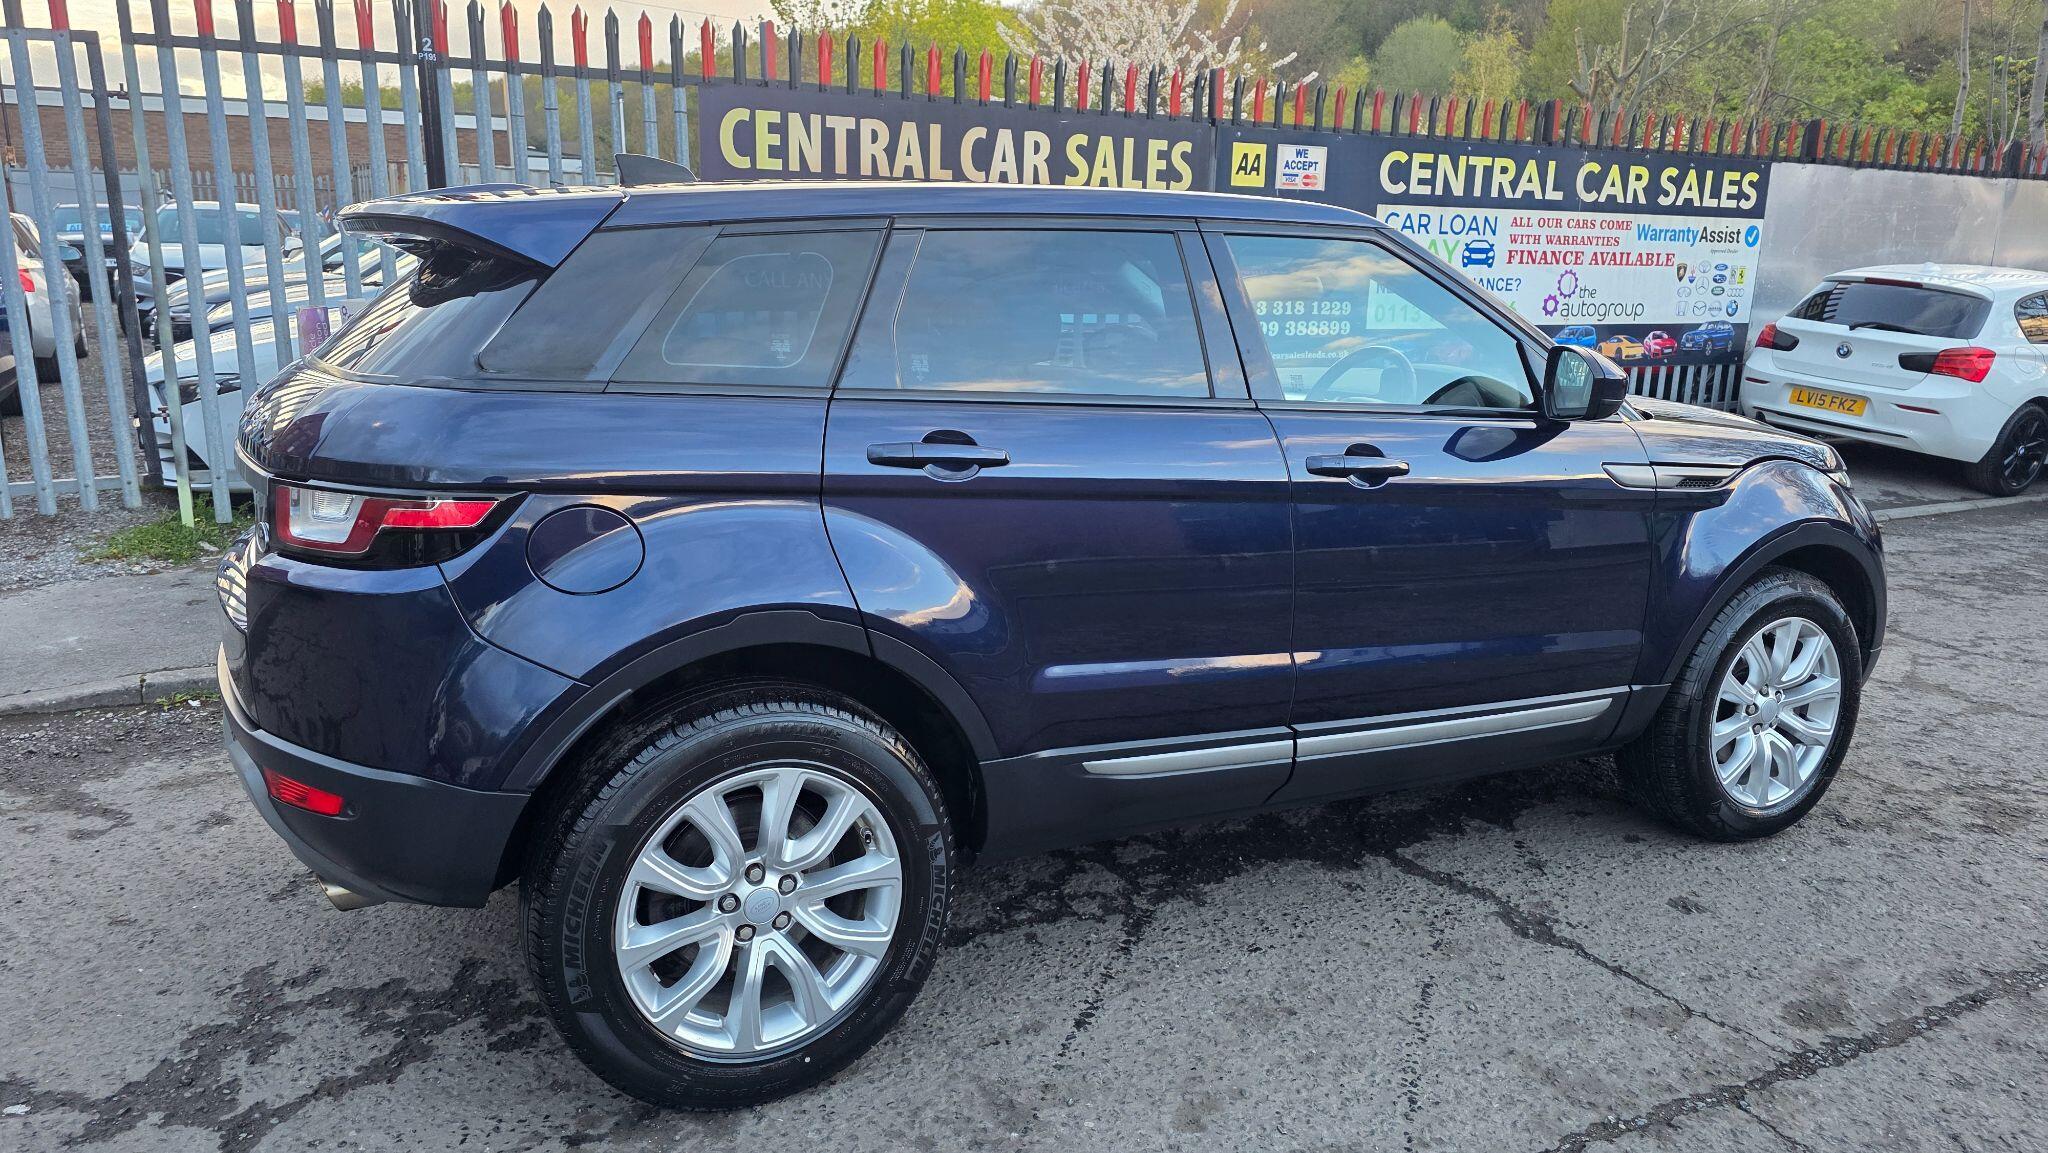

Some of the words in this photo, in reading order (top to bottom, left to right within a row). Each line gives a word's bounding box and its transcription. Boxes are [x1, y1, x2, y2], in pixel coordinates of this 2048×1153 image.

[421, 37, 433, 52] 2
[719, 107, 953, 181] CENTRAL
[959, 126, 1051, 185] CAR
[1064, 133, 1193, 191] SALES
[1295, 148, 1309, 159] WE
[1235, 152, 1261, 176] AA
[1283, 160, 1319, 171] ACCEPT
[1379, 150, 1564, 201] CENTRAL
[1576, 161, 1650, 205] CAR
[1656, 165, 1760, 210] SALES
[1384, 212, 1431, 234] CAR
[1439, 214, 1498, 236] LOAN
[1511, 216, 1533, 228] ALL
[1537, 217, 1563, 229] OUR
[1567, 218, 1596, 230] CARS
[1600, 219, 1633, 231] COME
[1509, 233, 1541, 245] WITH
[1546, 234, 1620, 247] WARRANTIES
[1506, 249, 1585, 266] FINANCE
[1589, 251, 1676, 267] AVAILABLE
[1579, 285, 1597, 299] the
[1272, 301, 1305, 315] 318
[1311, 301, 1352, 315] 1229
[1560, 300, 1645, 322] autogroup
[1797, 390, 1827, 406] LV15
[1828, 396, 1858, 412] FKZ
[565, 840, 606, 969] MICHELIN
[909, 865, 946, 981] MICHELIN
